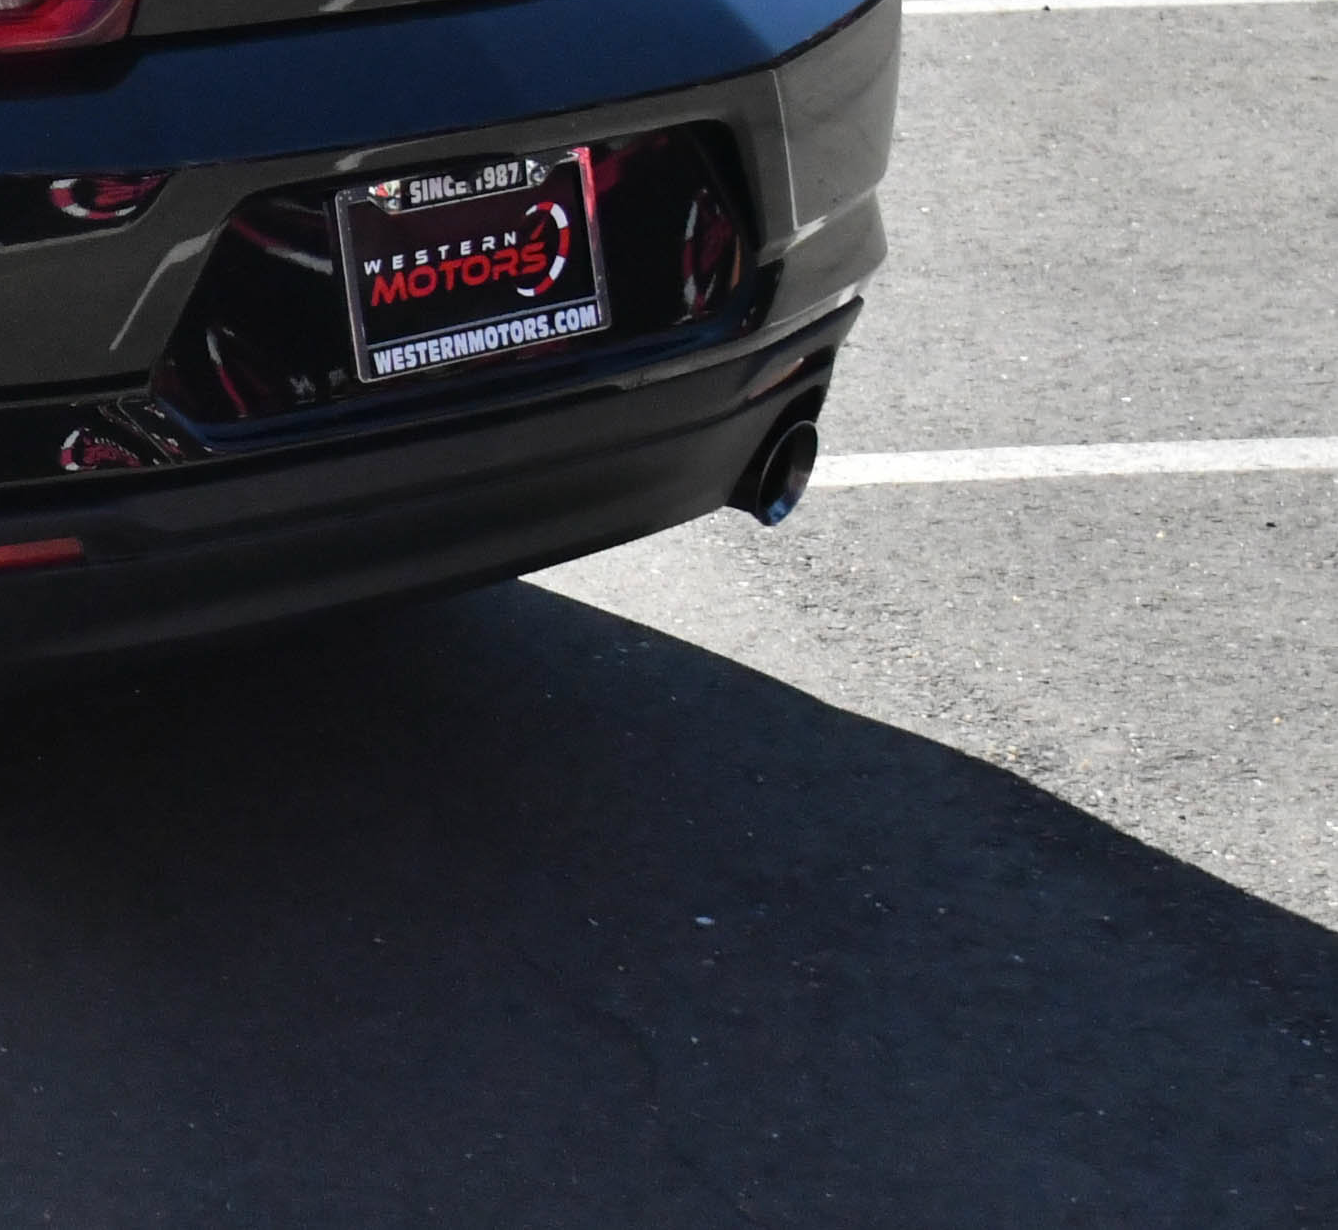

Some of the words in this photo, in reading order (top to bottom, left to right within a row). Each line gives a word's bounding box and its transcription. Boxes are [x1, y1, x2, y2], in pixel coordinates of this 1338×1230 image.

[409, 175, 467, 204] SINCE
[364, 231, 517, 276] WESTERN
[371, 241, 548, 307] MOTORS
[373, 303, 598, 376] WESTERNMOTORS.COM
